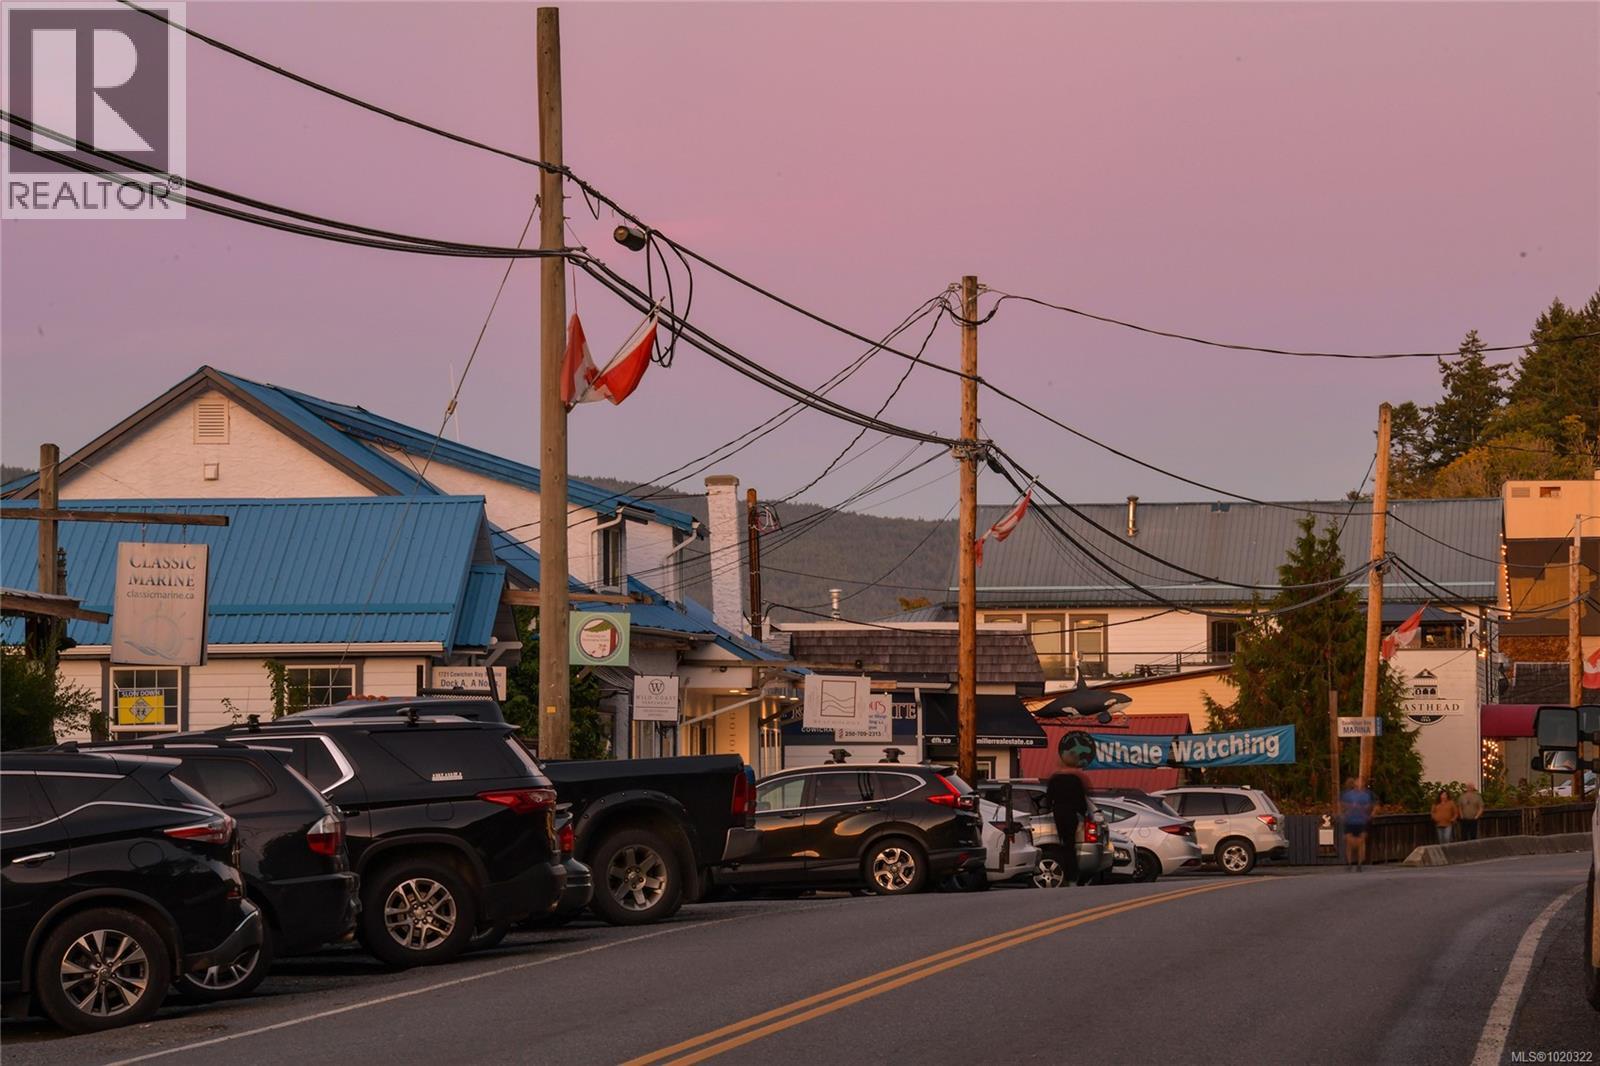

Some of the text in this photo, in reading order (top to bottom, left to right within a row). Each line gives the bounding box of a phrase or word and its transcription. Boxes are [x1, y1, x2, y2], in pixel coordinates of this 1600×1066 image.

[129, 555, 197, 570] CLASSIC
[128, 574, 195, 588] MARINE
[126, 590, 195, 601] classicmarine.ca
[441, 679, 458, 688] Dock
[1403, 703, 1460, 712] ASTHEAD
[1343, 726, 1371, 734] MARINA
[1095, 733, 1280, 765] Whale Watching
